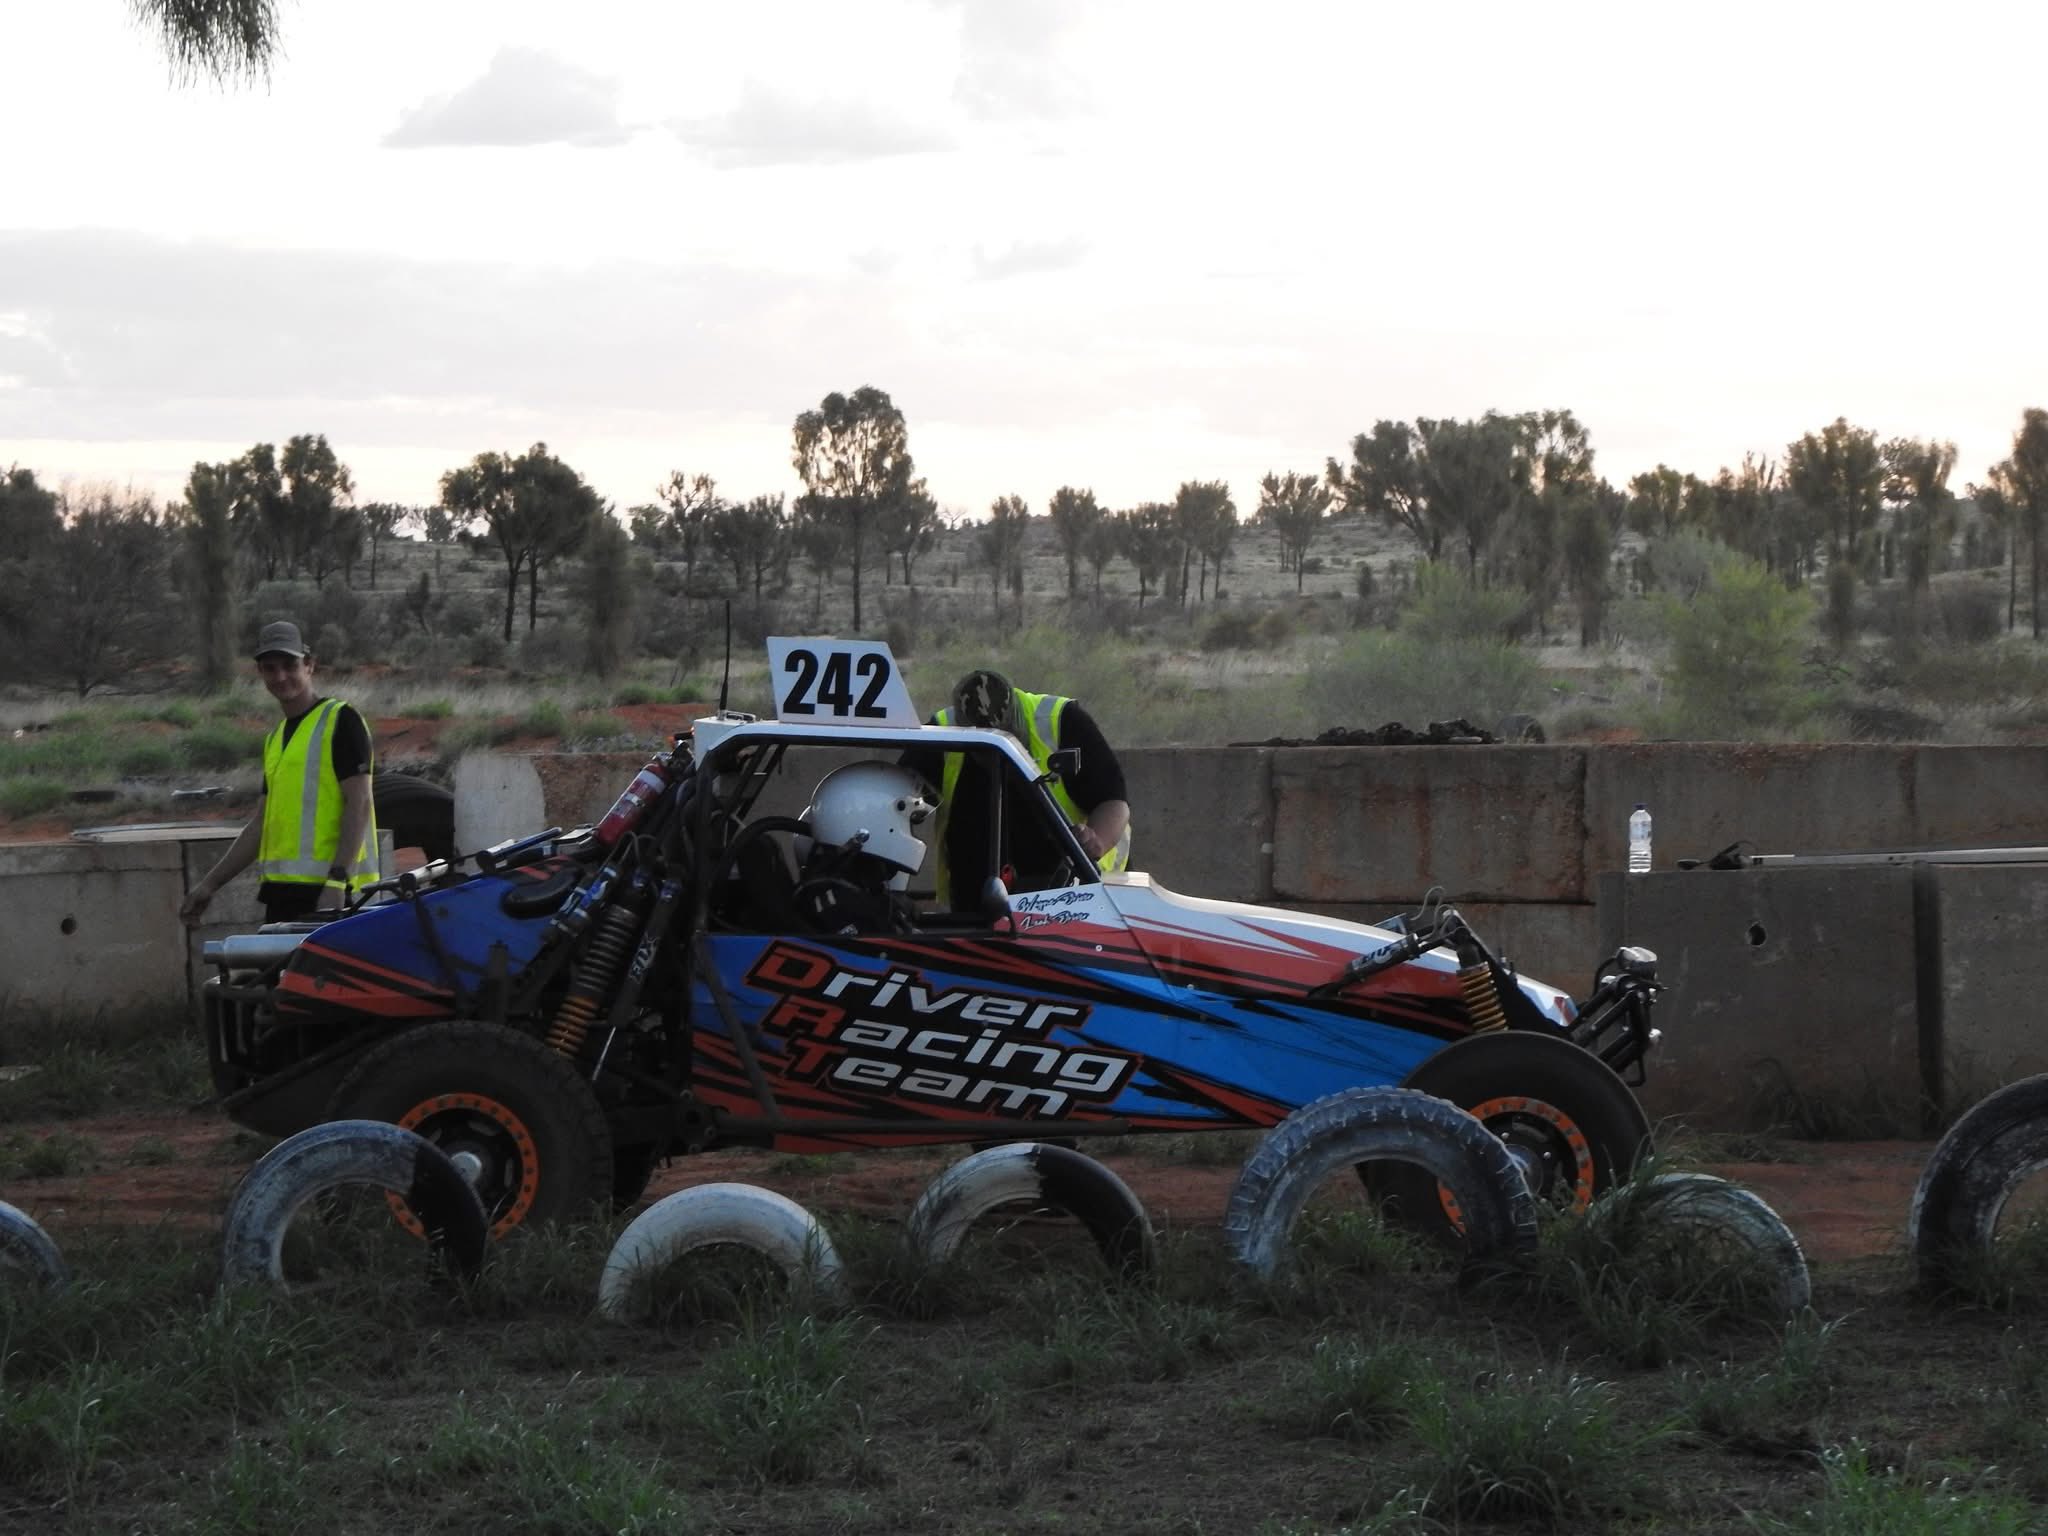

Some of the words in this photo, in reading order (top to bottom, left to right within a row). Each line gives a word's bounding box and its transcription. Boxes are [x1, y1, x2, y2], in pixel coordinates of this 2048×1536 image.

[783, 648, 891, 719] 242
[753, 948, 1080, 1030] Driver
[769, 996, 1130, 1094] Racing
[788, 1038, 1069, 1116] Team
